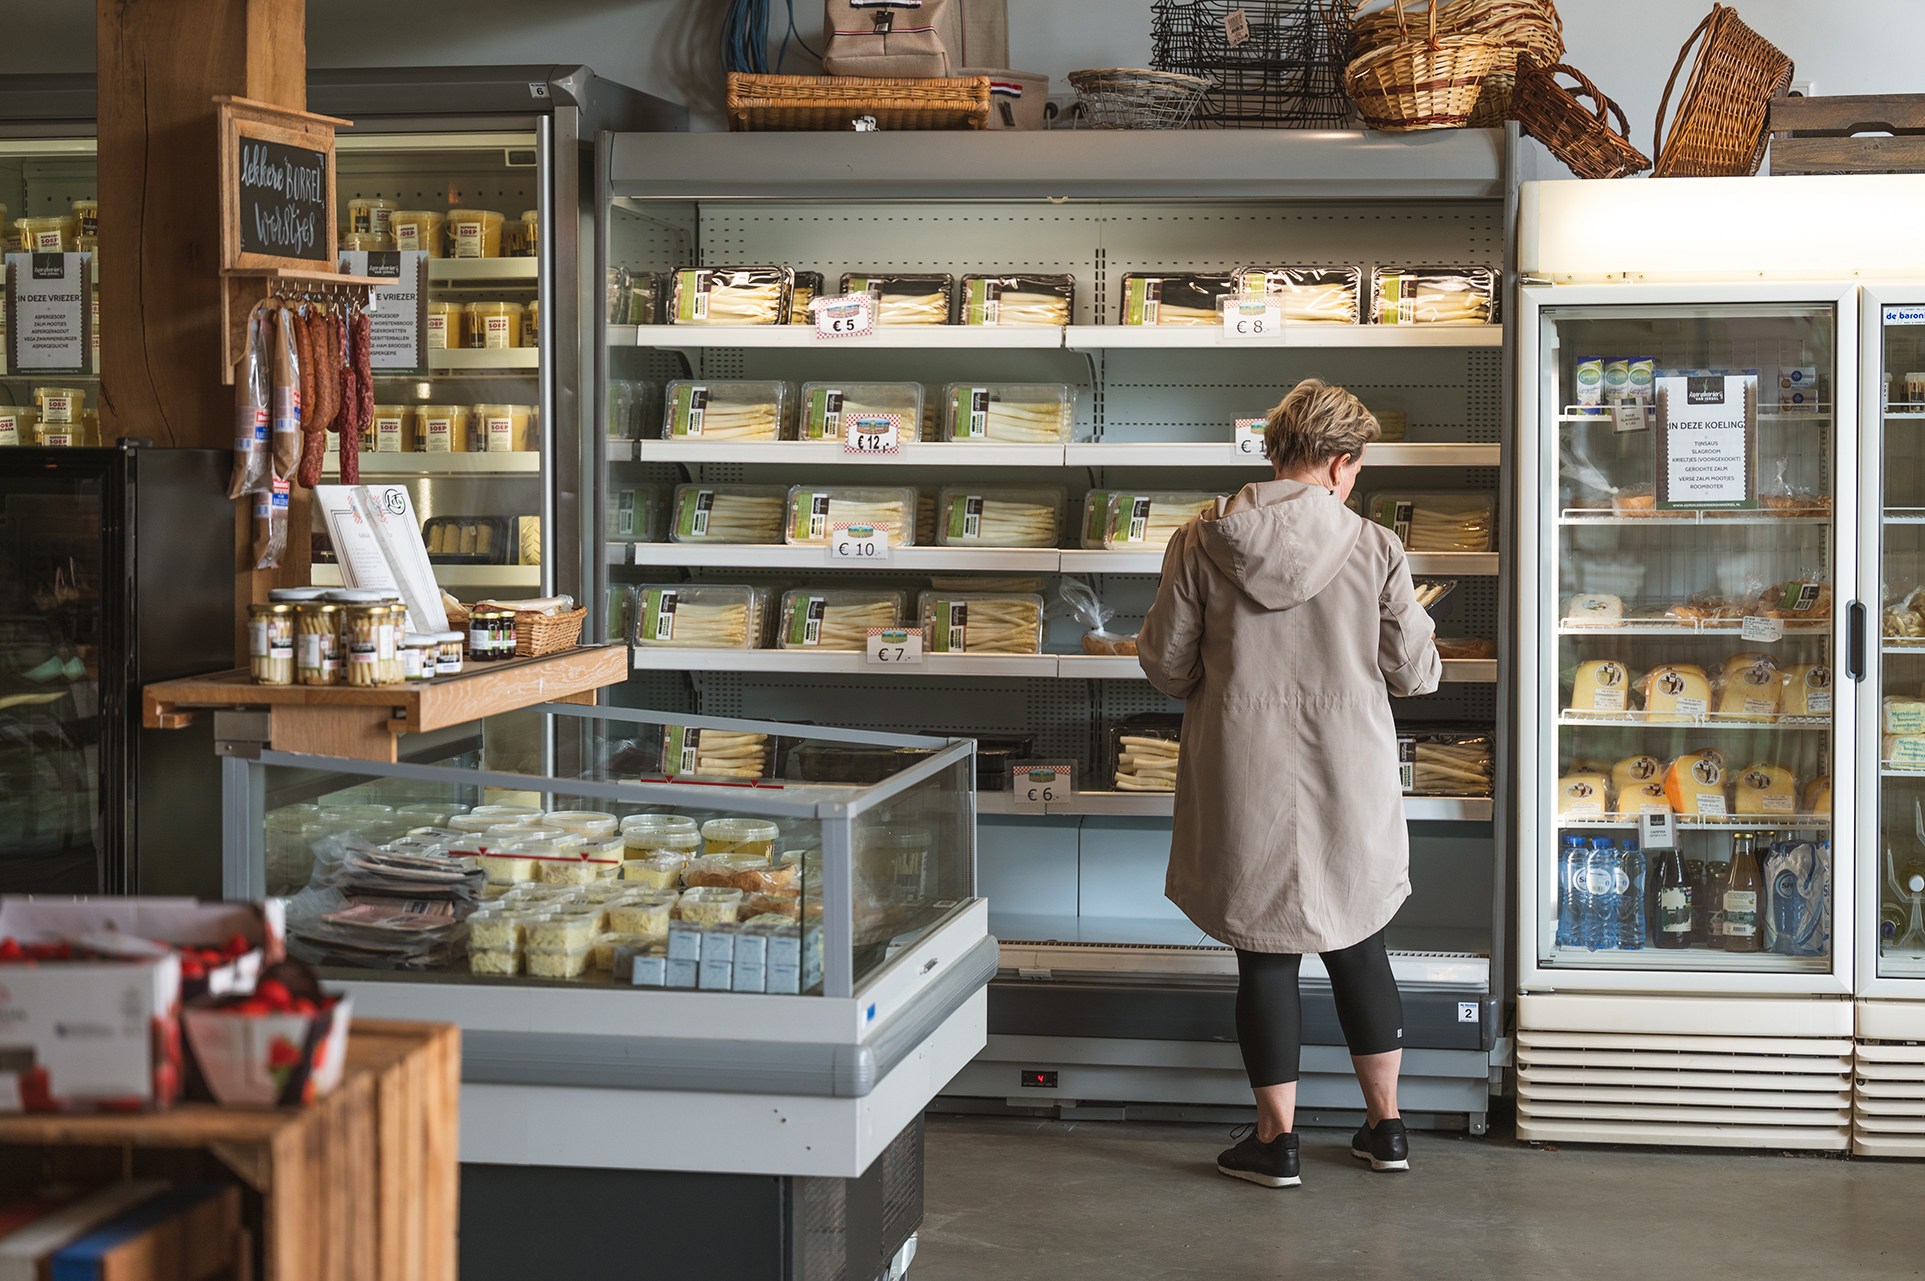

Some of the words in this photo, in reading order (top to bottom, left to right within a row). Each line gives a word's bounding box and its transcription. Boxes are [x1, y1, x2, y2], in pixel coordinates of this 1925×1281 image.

[241, 144, 284, 191] lekkere
[832, 320, 842, 332] €
[846, 319, 855, 331] 5
[1237, 320, 1247, 333] €
[858, 435, 864, 449] €
[1241, 440, 1251, 453] €
[839, 542, 849, 556] €
[878, 648, 888, 661] €
[1028, 789, 1037, 801] €
[1465, 1009, 1472, 1018] 2
